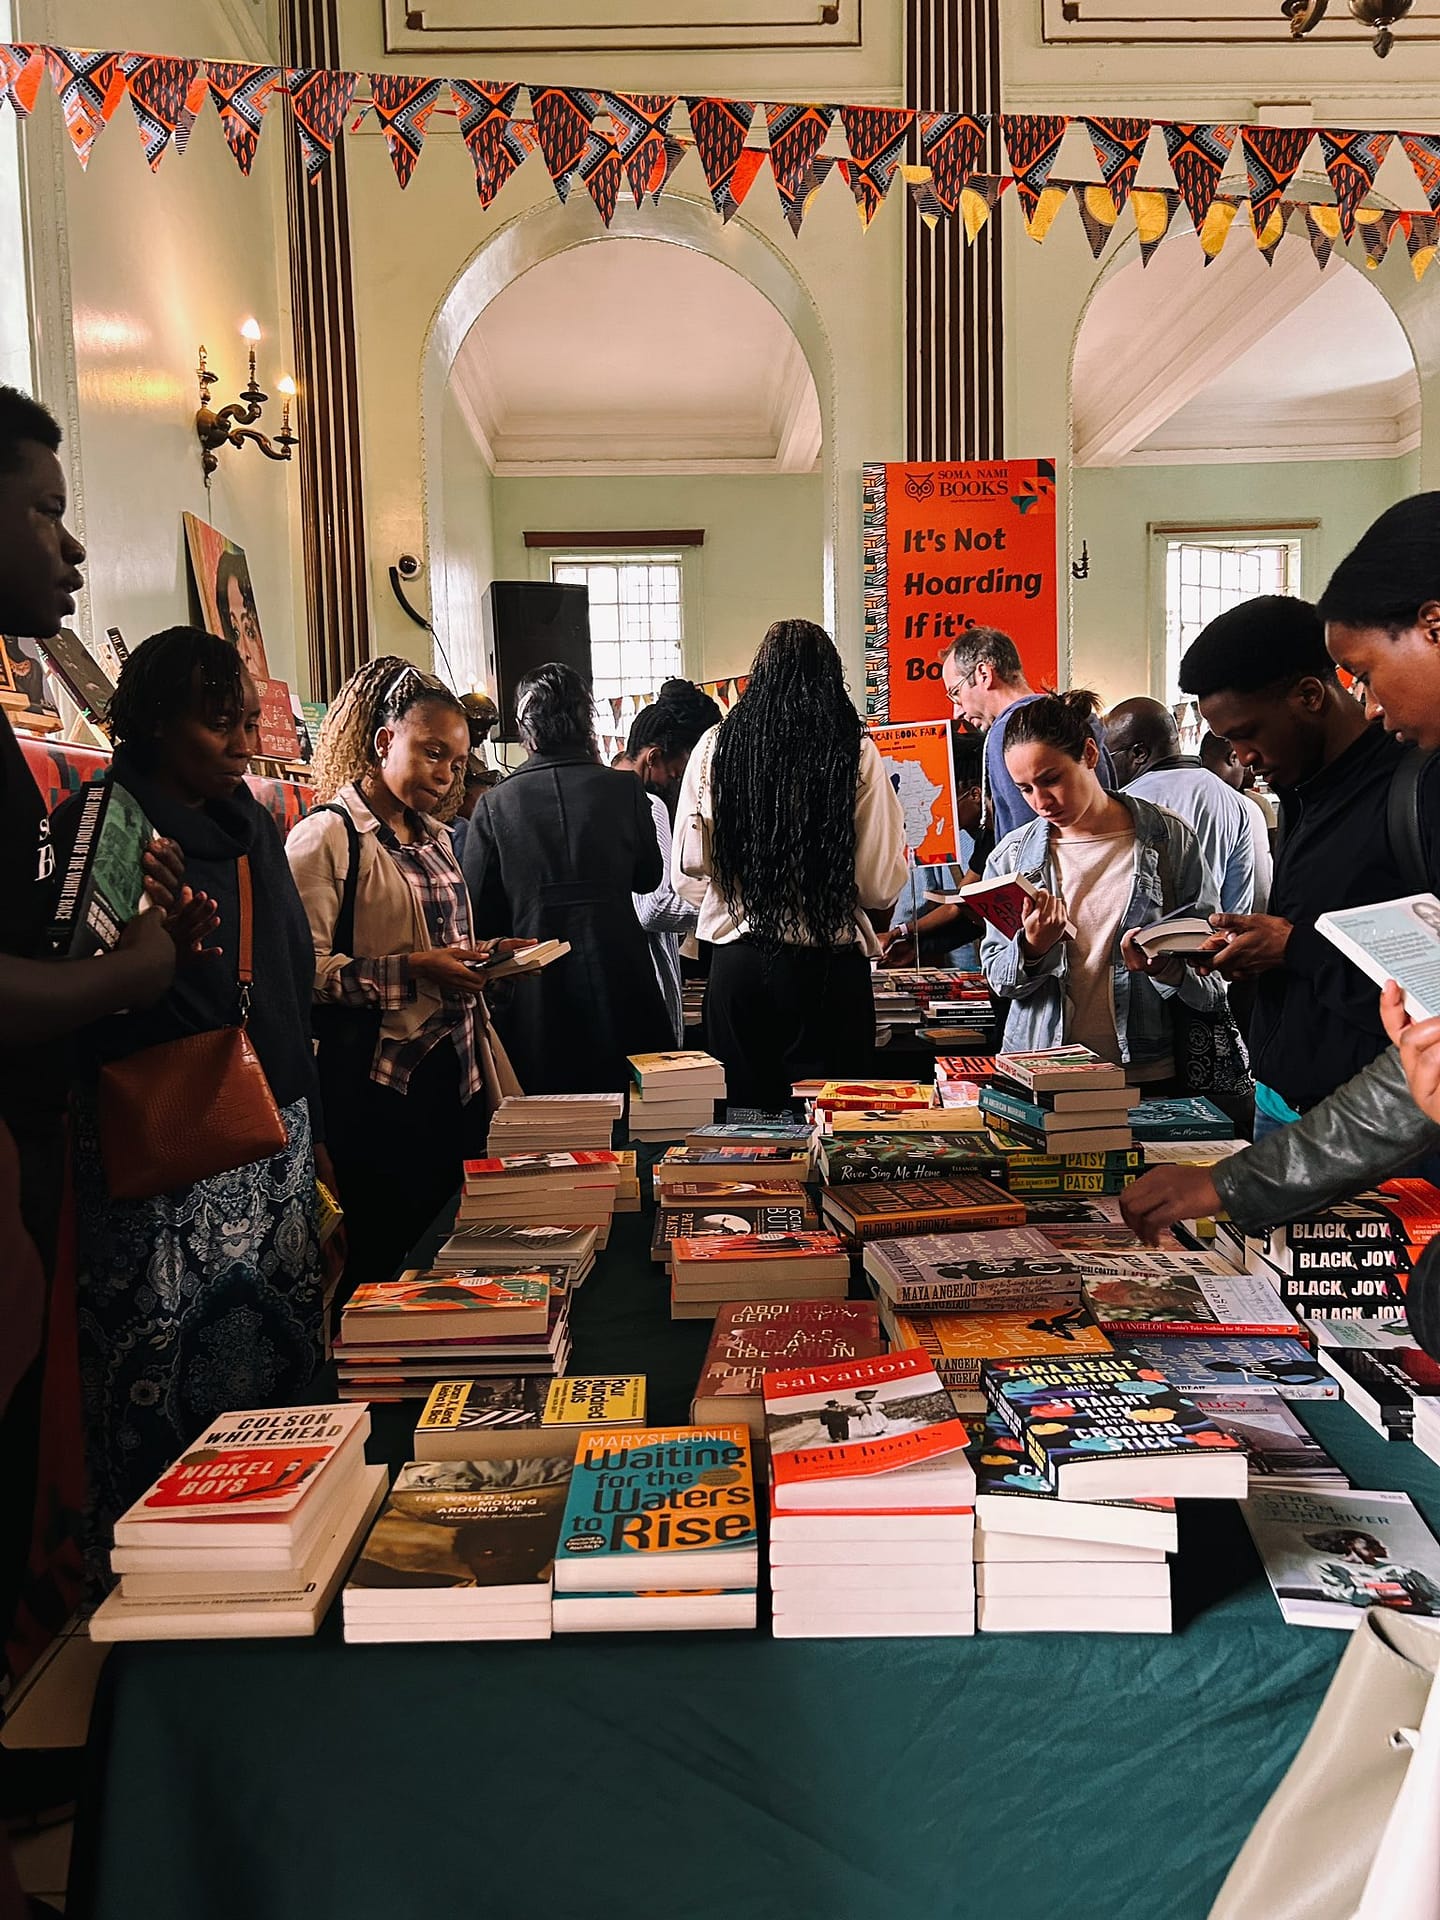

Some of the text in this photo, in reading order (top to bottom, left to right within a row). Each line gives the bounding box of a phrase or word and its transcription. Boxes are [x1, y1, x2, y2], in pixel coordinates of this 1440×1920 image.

[938, 468, 1008, 480] SOMA NAMI
[939, 480, 1008, 496] BOOKS
[904, 528, 1006, 554] It's Not
[904, 568, 1042, 600] Hoarding
[904, 613, 929, 639] If
[920, 728, 937, 736] FAIR
[54, 787, 105, 920] THE INVENTION OF THE WHITE RACE
[1068, 1152, 1105, 1167] PATSY
[840, 1165, 868, 1181] River
[870, 1166, 891, 1181] Sing
[893, 1165, 912, 1179] Me
[913, 1164, 942, 1178] Home
[1066, 1175, 1102, 1190] PATSY
[863, 1220, 892, 1236] BLOOD
[916, 1218, 951, 1232] BRONZE
[1292, 1222, 1391, 1239] BLACK JOY
[1300, 1251, 1397, 1268] BLACK JOY
[902, 1282, 978, 1301] MAYA ANGELOU
[1287, 1280, 1388, 1297] BLACK JOY
[1311, 1306, 1406, 1320] BLACK JOY
[1103, 1322, 1124, 1330] MAYA
[1126, 1322, 1165, 1332] ANGELOU
[1204, 1326, 1225, 1334] Nothing
[776, 1357, 918, 1390] salvation
[1005, 1360, 1138, 1377] ZORA NEALE
[944, 1372, 979, 1384] ANGELO
[1028, 1371, 1132, 1386] HURSTON
[570, 1379, 590, 1405] Souls
[610, 1378, 631, 1397] Four
[1065, 1384, 1111, 1393] HITTING
[588, 1379, 610, 1420] Hundred
[1050, 1394, 1150, 1409] STRAIGHT
[238, 1412, 334, 1430] COLSON
[1084, 1406, 1134, 1420] LICK
[1096, 1418, 1128, 1426] WITH
[204, 1424, 344, 1444] WHITEHEAD
[588, 1431, 671, 1448] MARYSE
[1076, 1423, 1184, 1440] CROOKED
[794, 1431, 943, 1464] bell hooks
[1105, 1436, 1178, 1451] STICK
[584, 1446, 747, 1472] Waiting
[178, 1461, 272, 1480] NICKEL
[176, 1478, 248, 1498] BOYS
[596, 1470, 693, 1489] for the
[416, 1494, 437, 1502] THE
[444, 1494, 496, 1502] WORLD
[478, 1498, 538, 1506] MOVING
[594, 1486, 750, 1514] Waters
[436, 1506, 499, 1514] AROUND
[1333, 1514, 1390, 1524] RIVER
[572, 1515, 602, 1532] to
[609, 1513, 752, 1552] Rise
